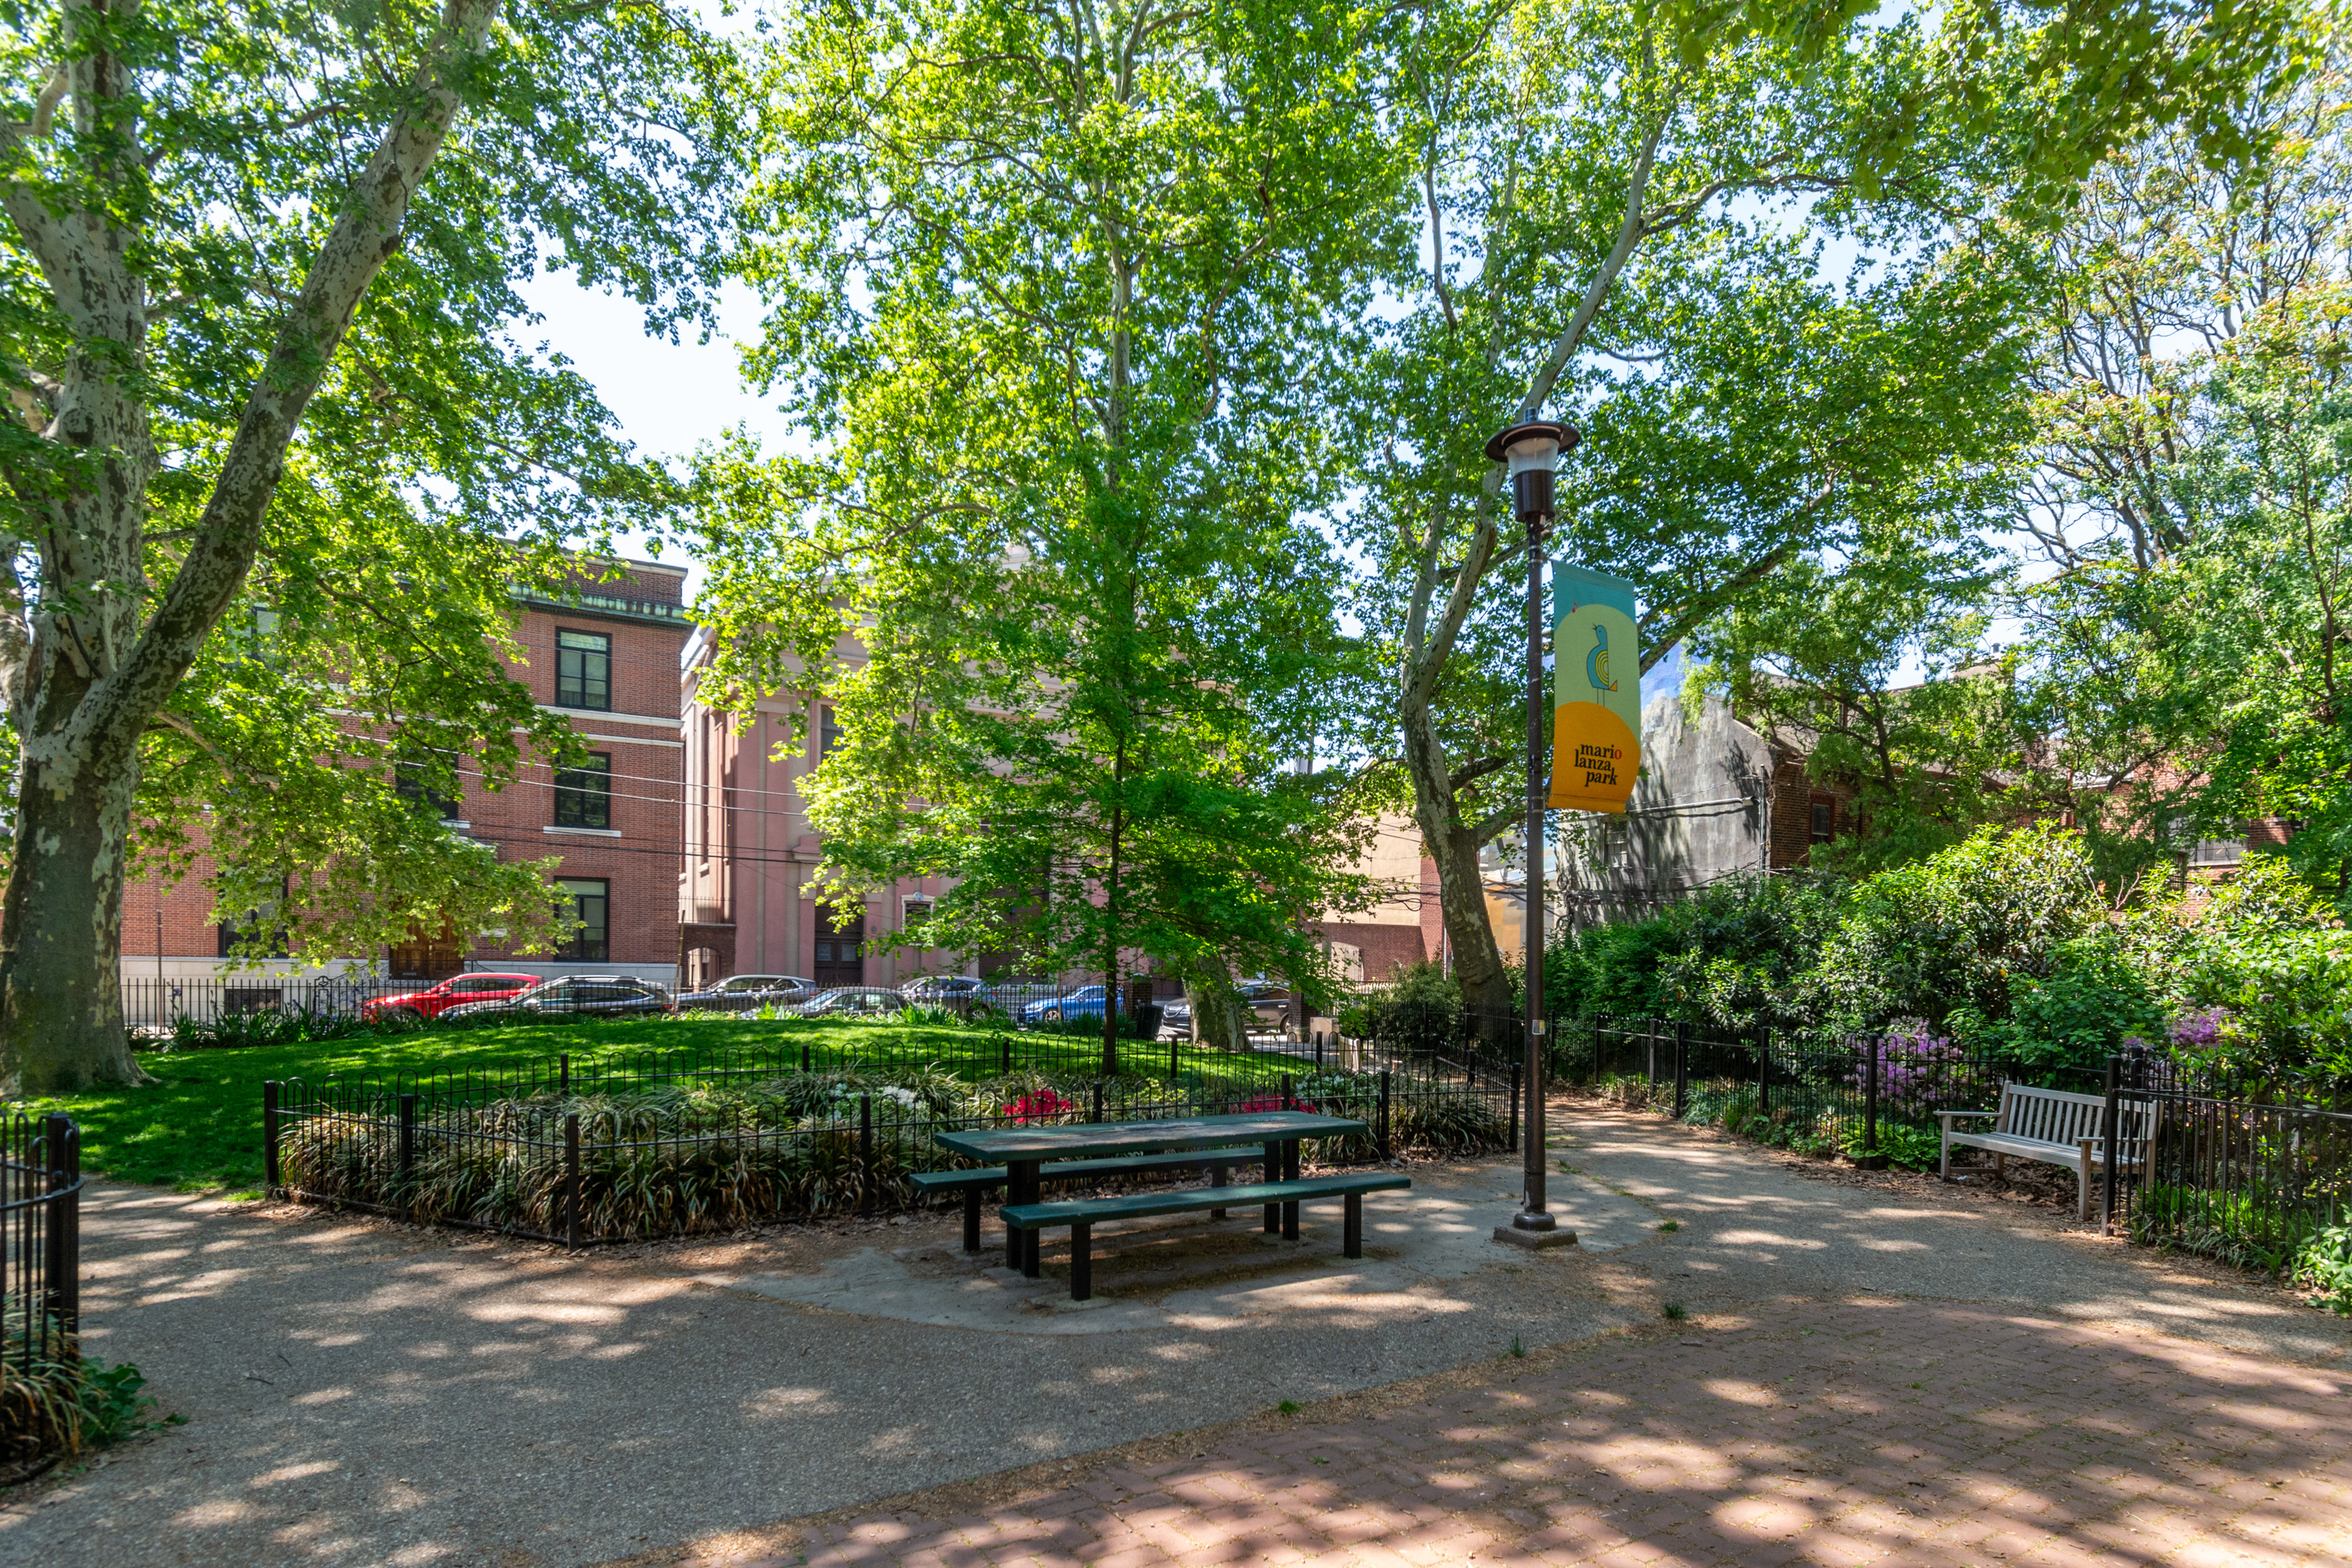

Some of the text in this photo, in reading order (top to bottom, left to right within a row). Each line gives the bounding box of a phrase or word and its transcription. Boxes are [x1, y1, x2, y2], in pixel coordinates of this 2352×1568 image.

[1574, 749, 1611, 771] lanza
[1580, 744, 1622, 760] mario
[1584, 767, 1619, 787] park
